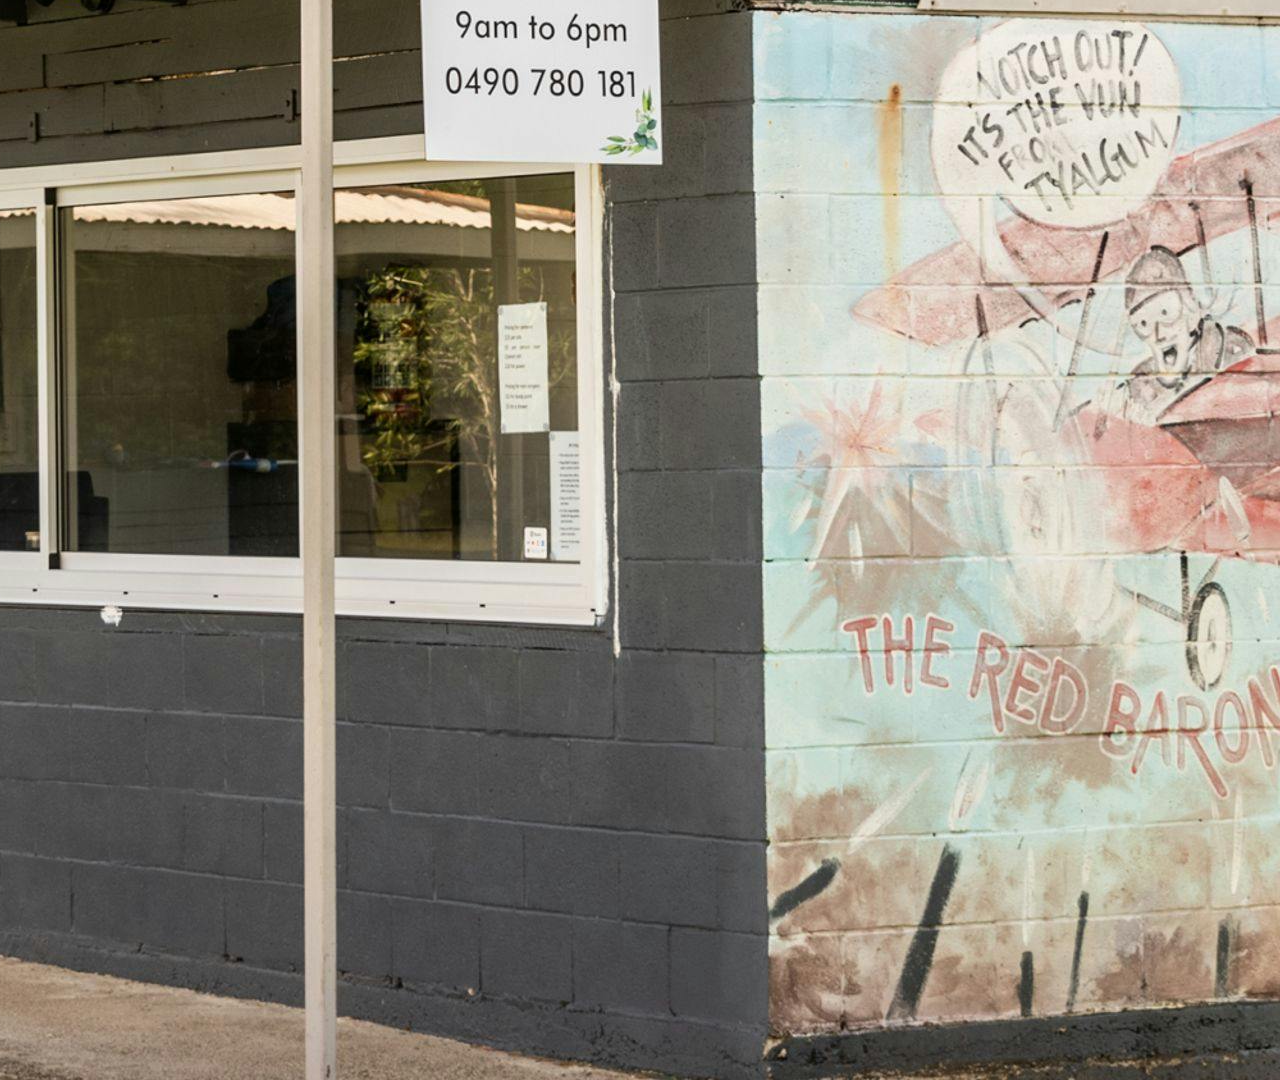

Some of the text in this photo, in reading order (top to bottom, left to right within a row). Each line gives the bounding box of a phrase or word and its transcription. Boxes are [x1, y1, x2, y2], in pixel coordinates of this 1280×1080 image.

[455, 10, 628, 49] 9am to 6pm
[1073, 29, 1149, 77] OUT!
[445, 67, 636, 98] 0490 780 181
[1006, 85, 1069, 134] THE
[842, 613, 954, 696] THE
[968, 629, 1087, 736] RED
